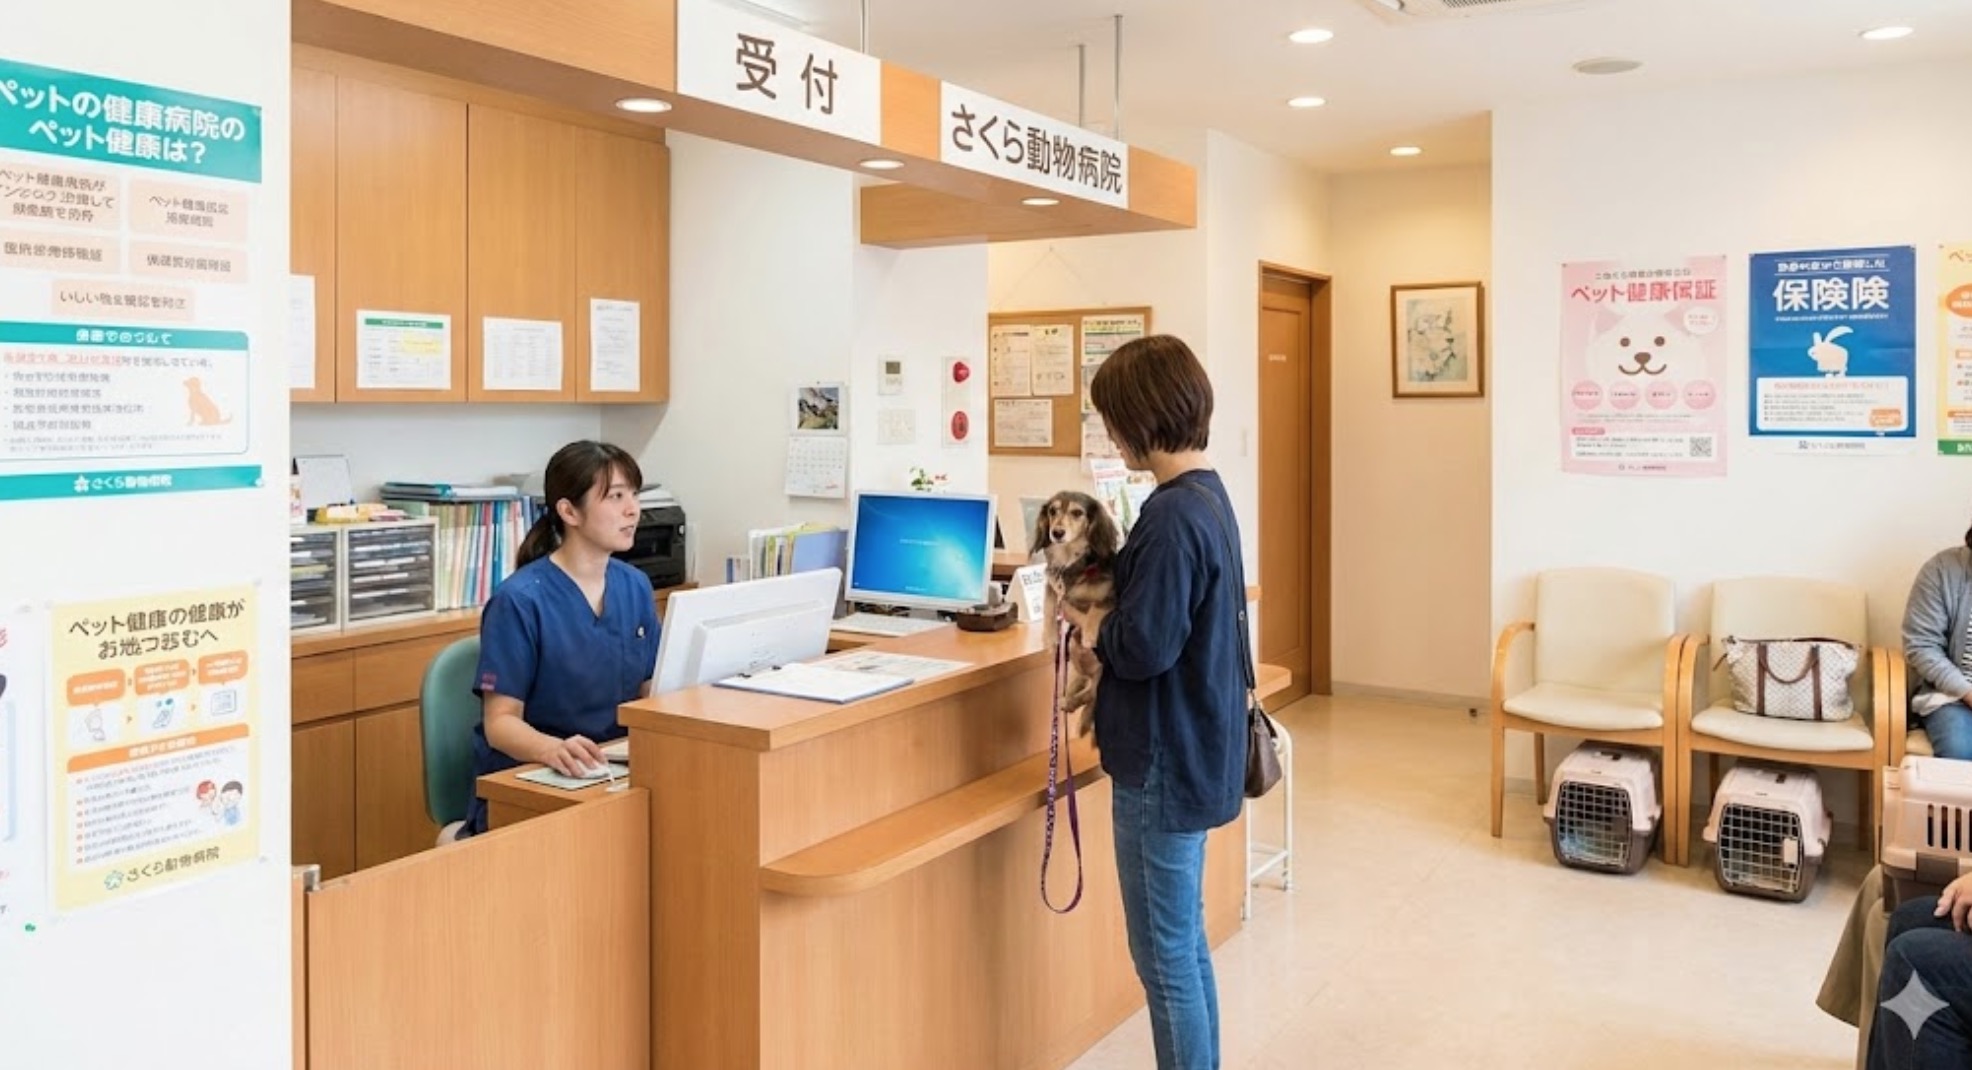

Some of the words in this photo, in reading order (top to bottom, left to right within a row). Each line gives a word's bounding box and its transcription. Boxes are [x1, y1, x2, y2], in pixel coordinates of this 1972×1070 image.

[736, 33, 838, 115] 受付
[951, 104, 1123, 194] さくら動物病院
[1772, 275, 1890, 312] 保険険
